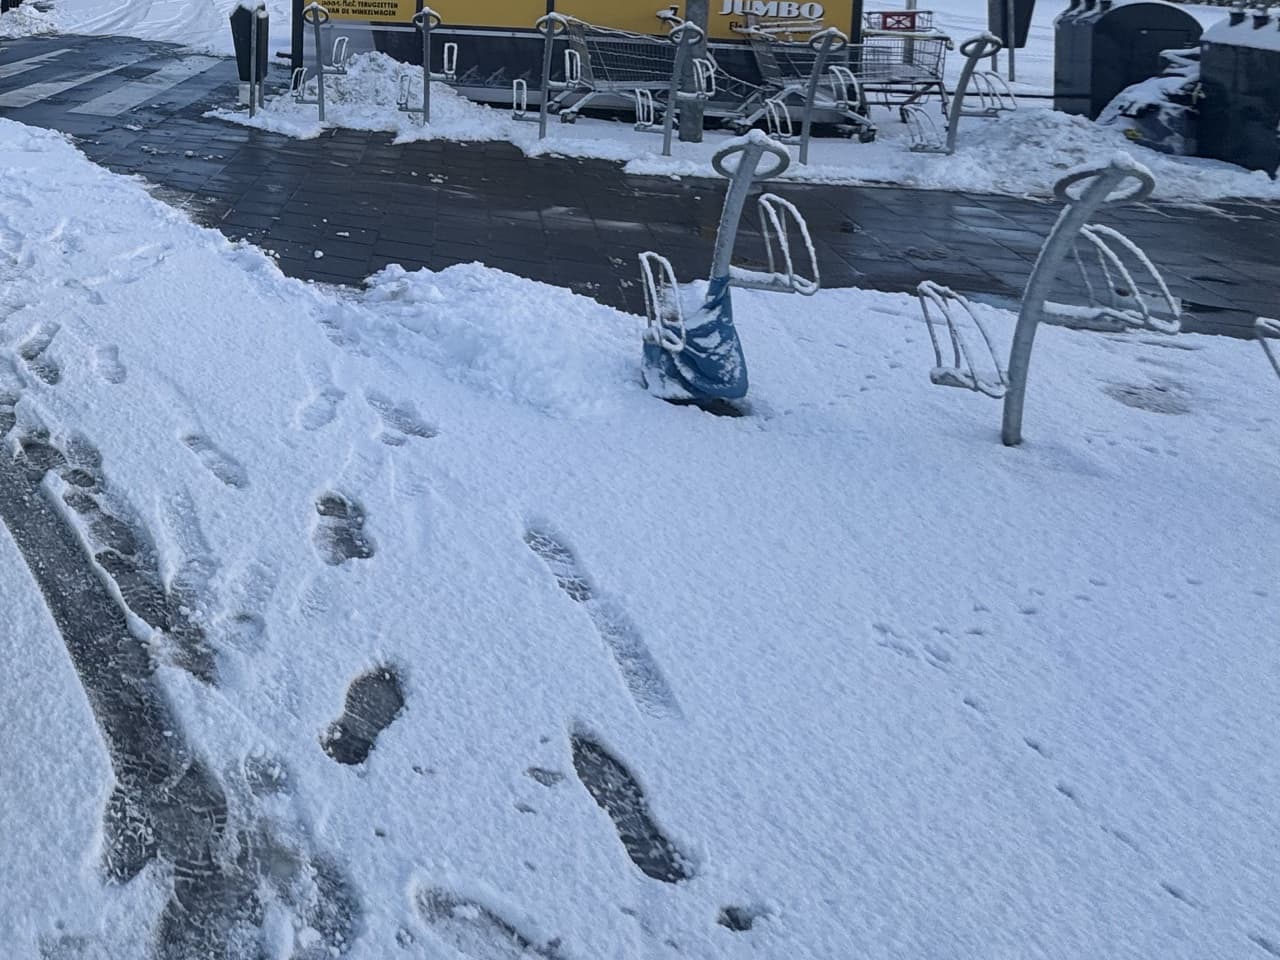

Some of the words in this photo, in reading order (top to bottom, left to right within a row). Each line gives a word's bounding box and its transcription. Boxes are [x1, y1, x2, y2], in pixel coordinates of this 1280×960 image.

[357, 0, 399, 9] TERUGZETTEN
[718, 0, 824, 19] JUMBO
[341, 7, 350, 15] DE
[351, 8, 397, 17] WINKELWAGEN
